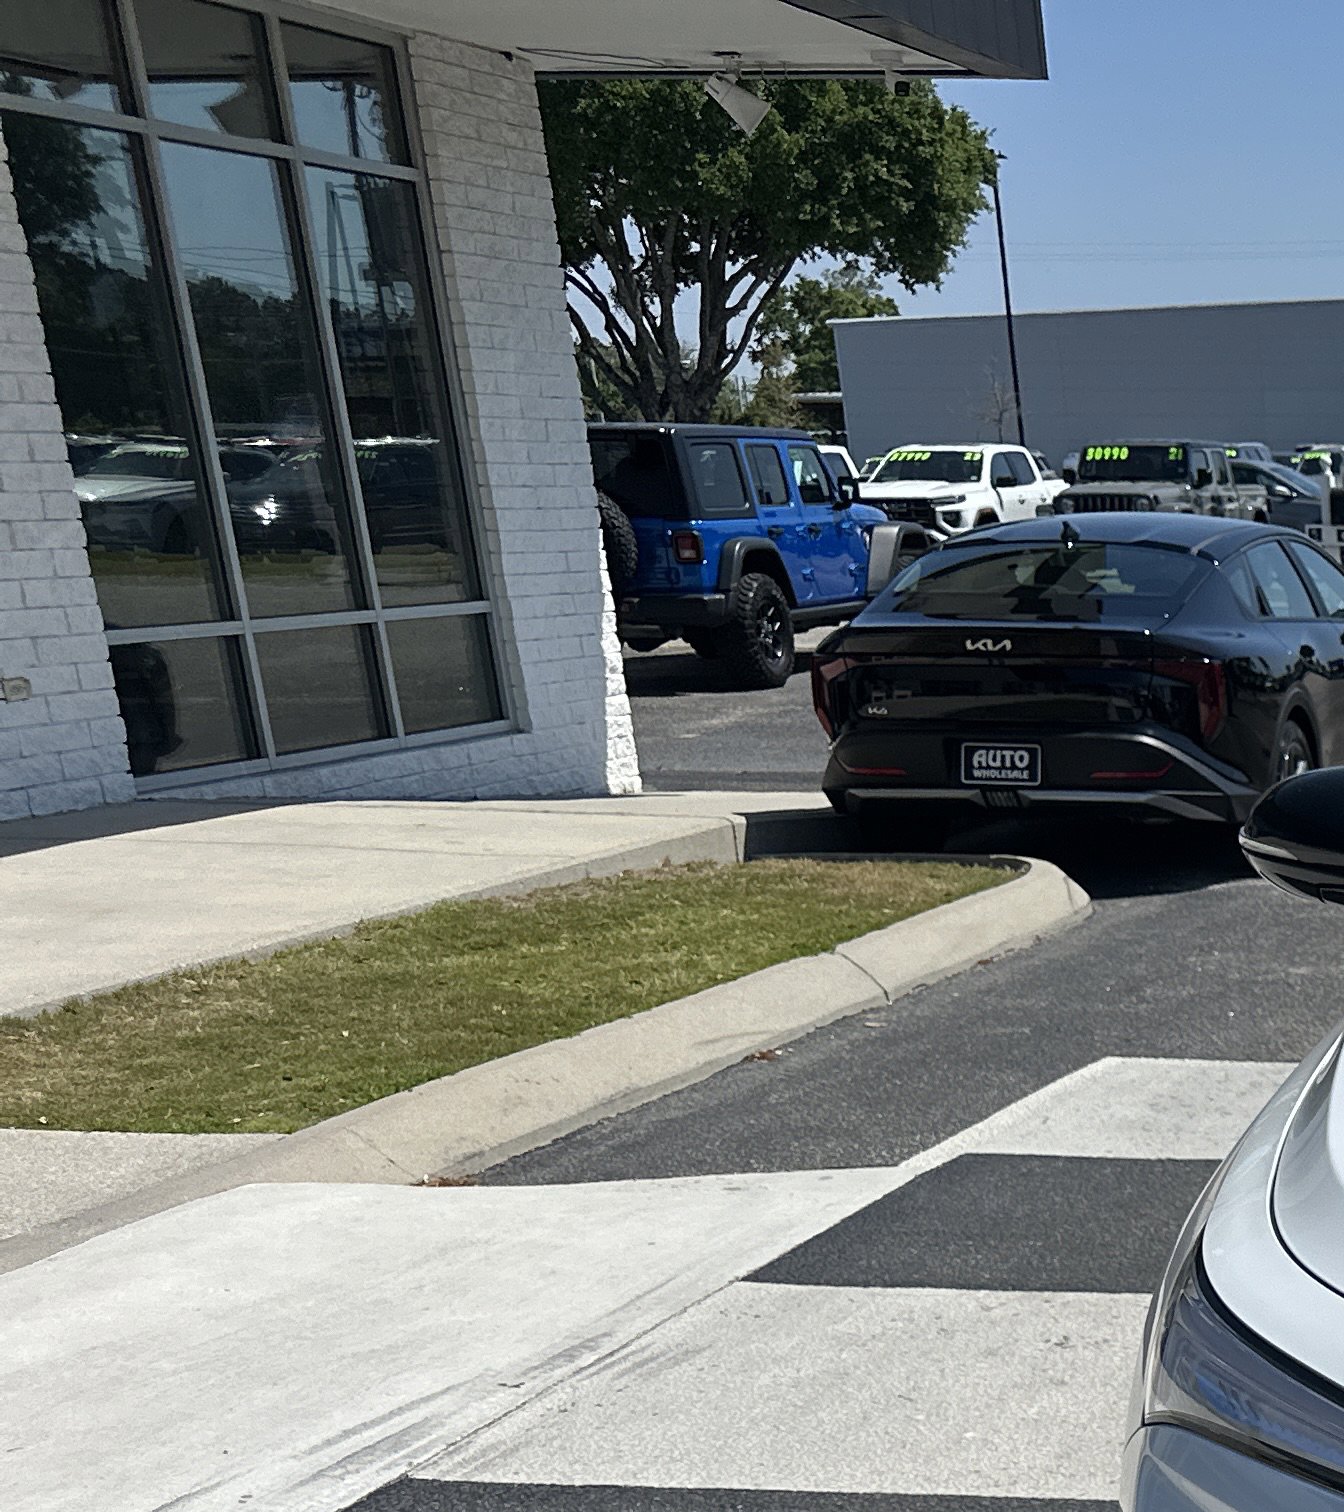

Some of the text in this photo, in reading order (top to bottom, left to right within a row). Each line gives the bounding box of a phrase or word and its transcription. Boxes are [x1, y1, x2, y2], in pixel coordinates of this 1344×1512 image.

[965, 639, 1012, 651] KIA
[972, 749, 1030, 769] AUTO
[972, 768, 1030, 780] WHOLESALE
